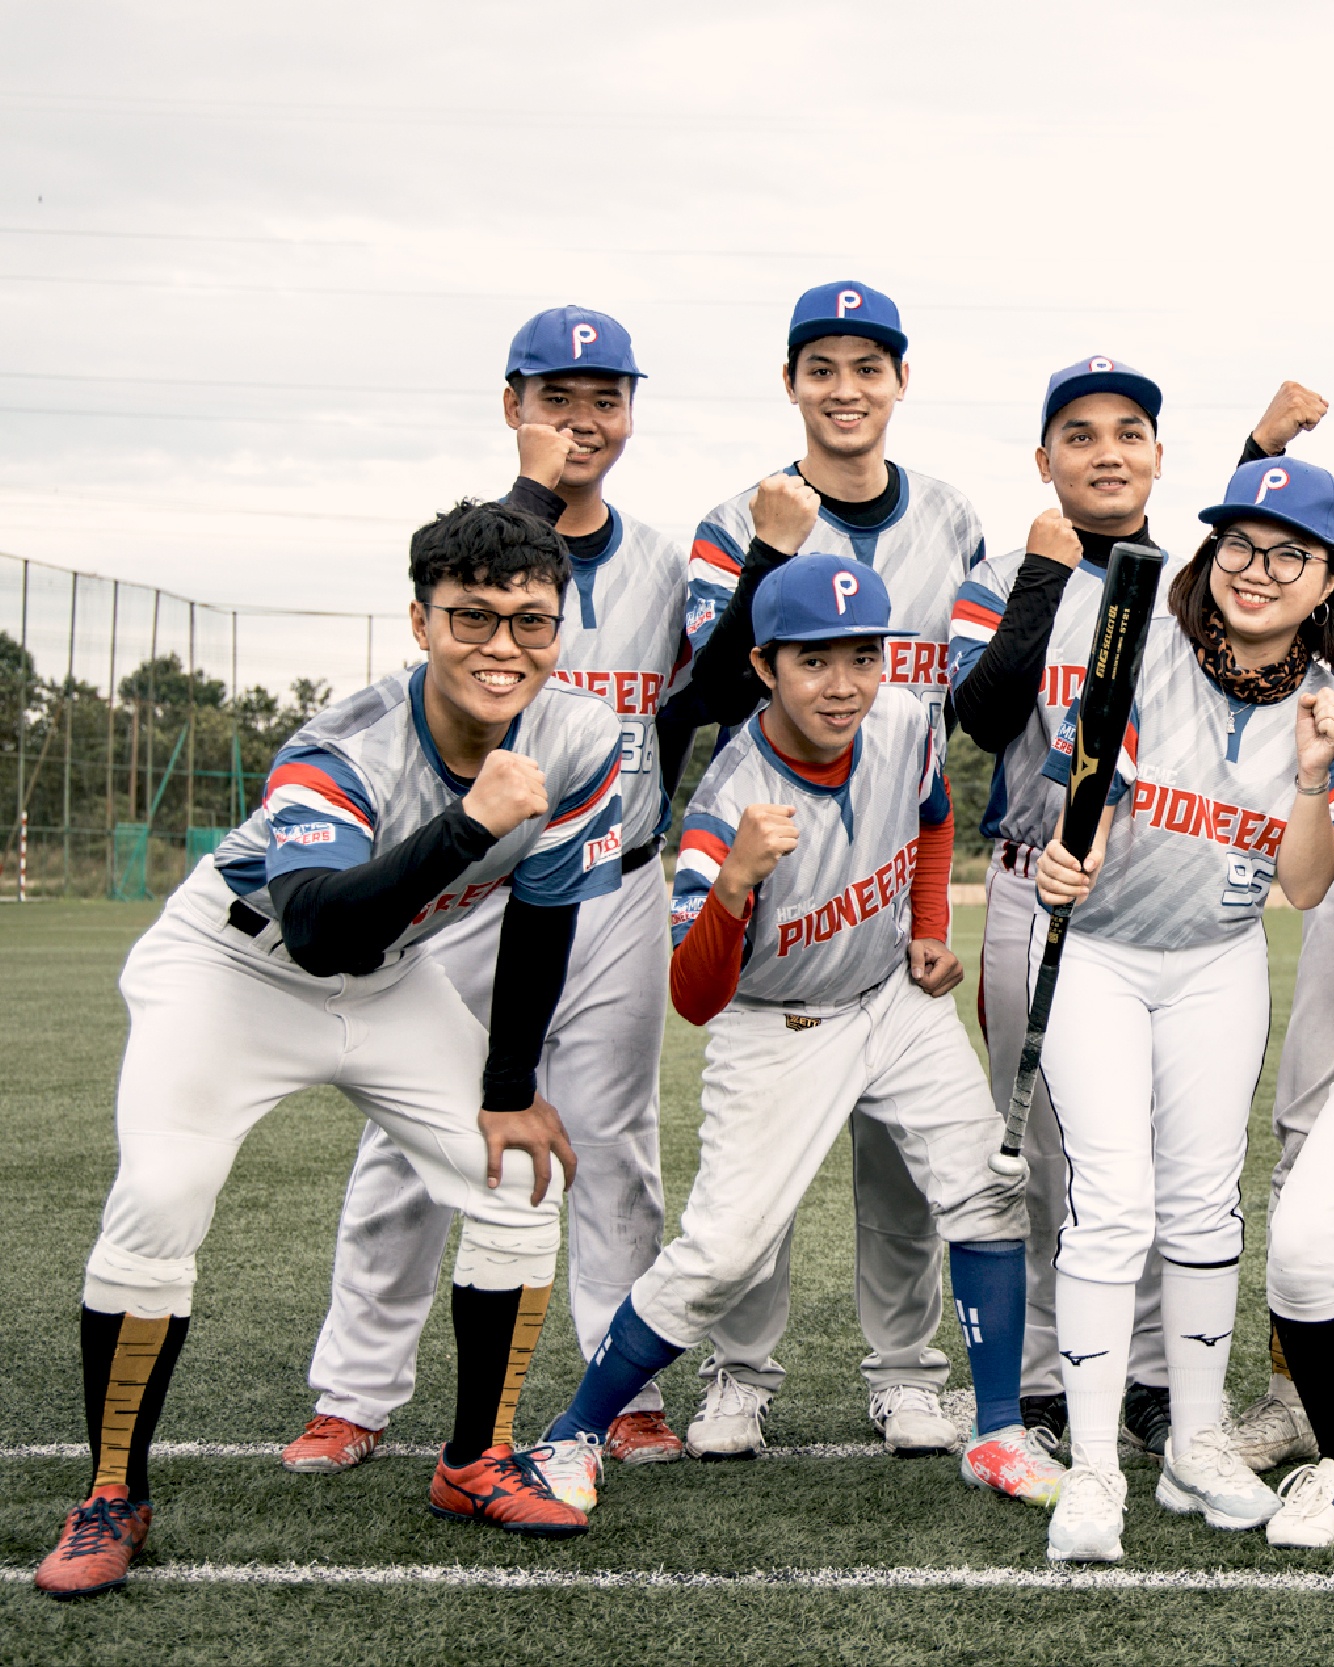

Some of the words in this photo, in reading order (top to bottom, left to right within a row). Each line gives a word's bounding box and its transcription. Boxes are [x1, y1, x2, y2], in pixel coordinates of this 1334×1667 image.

[837, 290, 862, 318] P
[572, 323, 598, 360] P
[1255, 467, 1291, 505] P
[832, 570, 860, 616] P
[1131, 779, 1288, 858] PIONEER
[777, 835, 920, 957] PIONEERS
